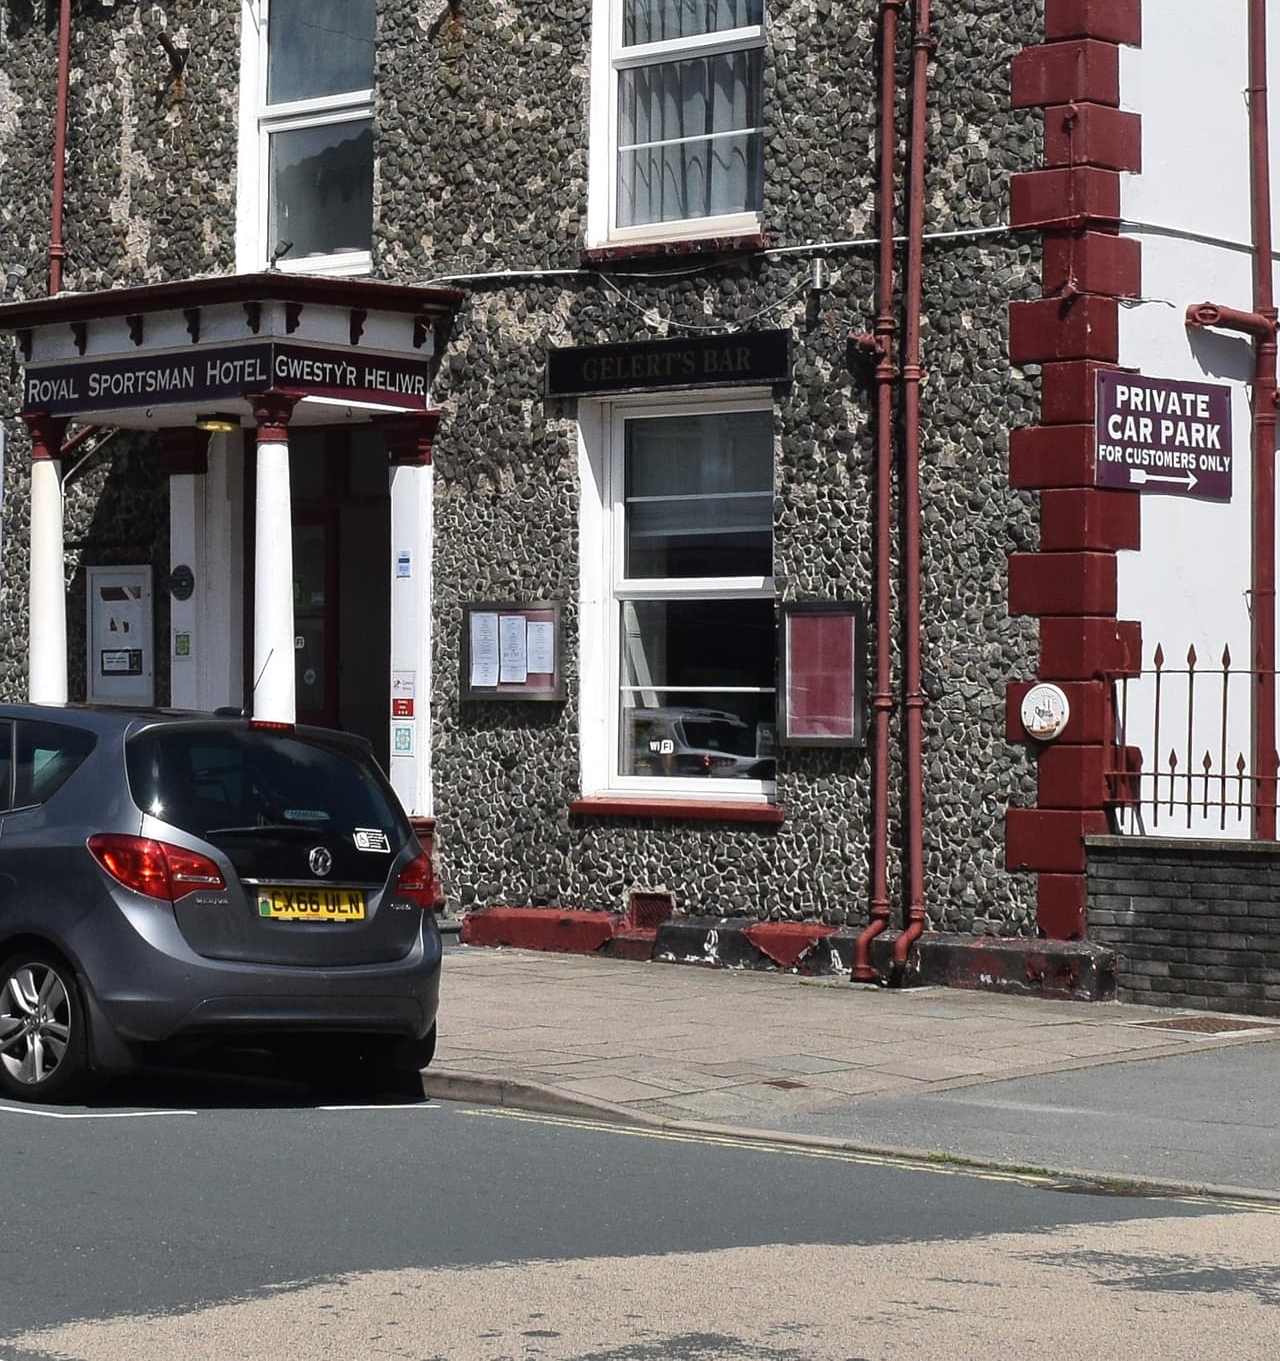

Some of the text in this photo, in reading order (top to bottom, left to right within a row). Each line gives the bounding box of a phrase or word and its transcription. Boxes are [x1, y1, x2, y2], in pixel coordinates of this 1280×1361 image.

[27, 358, 268, 403] ROYAL SPORTSMAN HOTEL
[274, 354, 426, 397] GWESTY'R HELIWR
[582, 347, 752, 382] GELERT'S BAR
[1115, 384, 1210, 419] PRIVATE
[1107, 414, 1221, 450] CAR PARK
[1098, 444, 1231, 473] FOR CUSTOMERS ONLY
[271, 890, 360, 915] CX66 ULN
